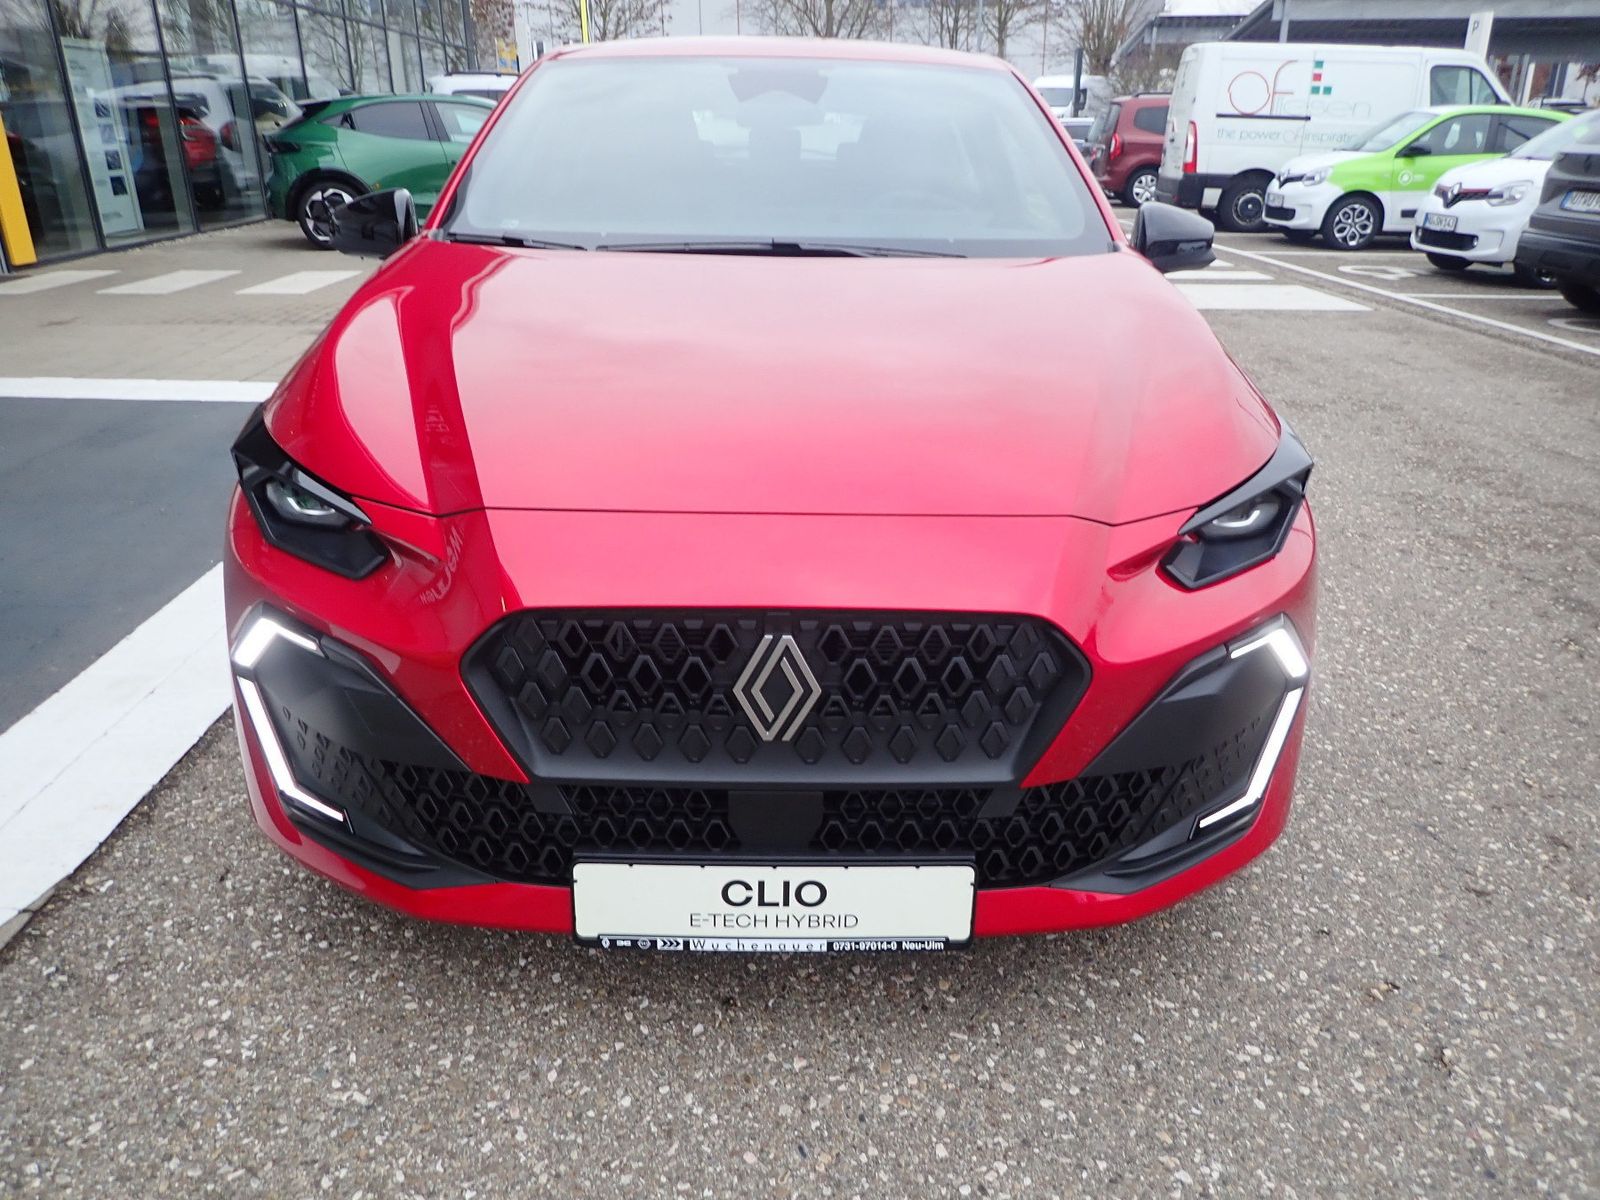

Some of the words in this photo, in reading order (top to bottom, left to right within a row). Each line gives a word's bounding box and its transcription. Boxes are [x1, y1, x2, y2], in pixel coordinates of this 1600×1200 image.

[1217, 127, 1237, 139] the
[1239, 128, 1281, 141] power
[721, 879, 828, 908] CLIO
[689, 913, 768, 928] E-TECH
[775, 913, 859, 929] HYBRID
[692, 938, 826, 951] Wuchenauer
[902, 941, 944, 951] Neu-Ulm
